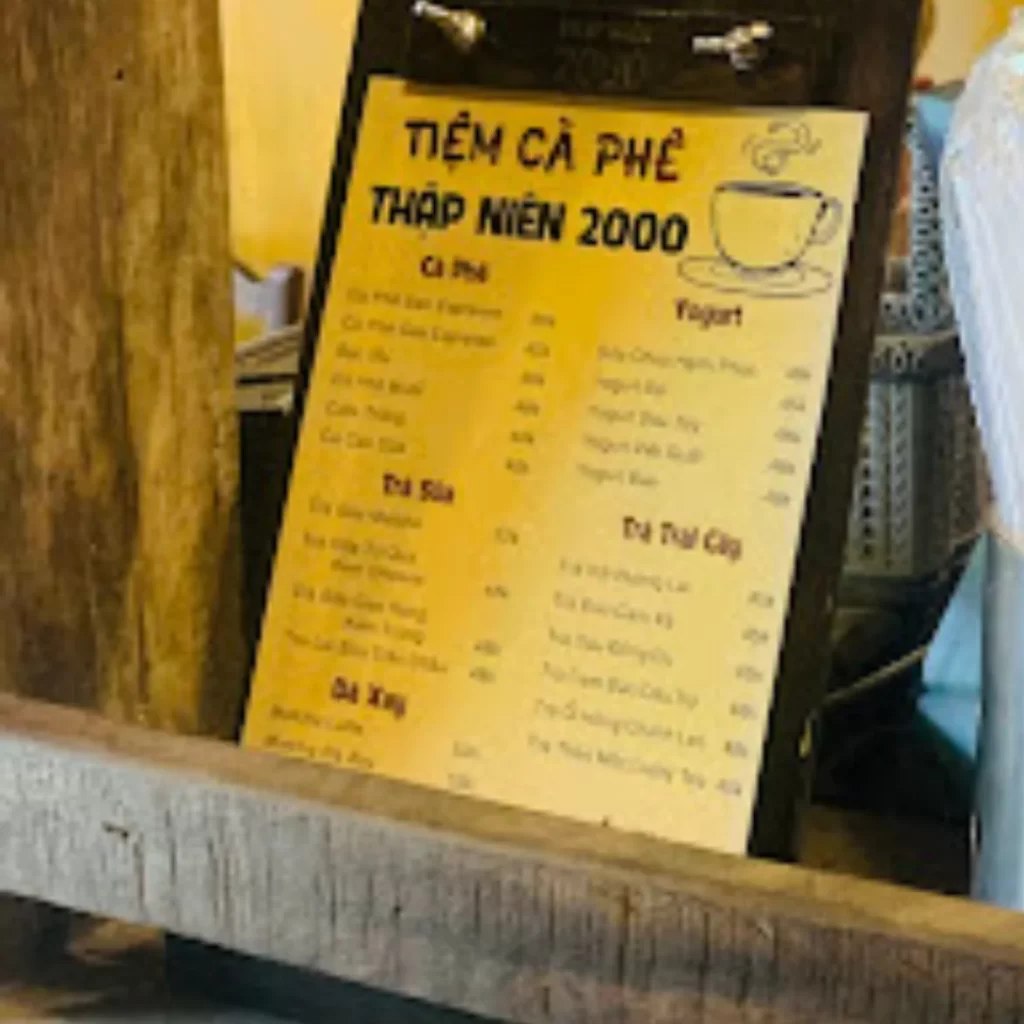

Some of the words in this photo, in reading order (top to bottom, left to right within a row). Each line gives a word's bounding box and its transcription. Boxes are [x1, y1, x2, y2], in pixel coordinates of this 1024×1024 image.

[404, 112, 502, 174] TIỆM
[517, 117, 574, 171] CÀ
[594, 127, 684, 183] PHÊ
[370, 184, 465, 240] THẬP
[477, 190, 566, 242] NIÊN
[578, 207, 689, 253] 2000
[675, 297, 743, 331] Yogurt
